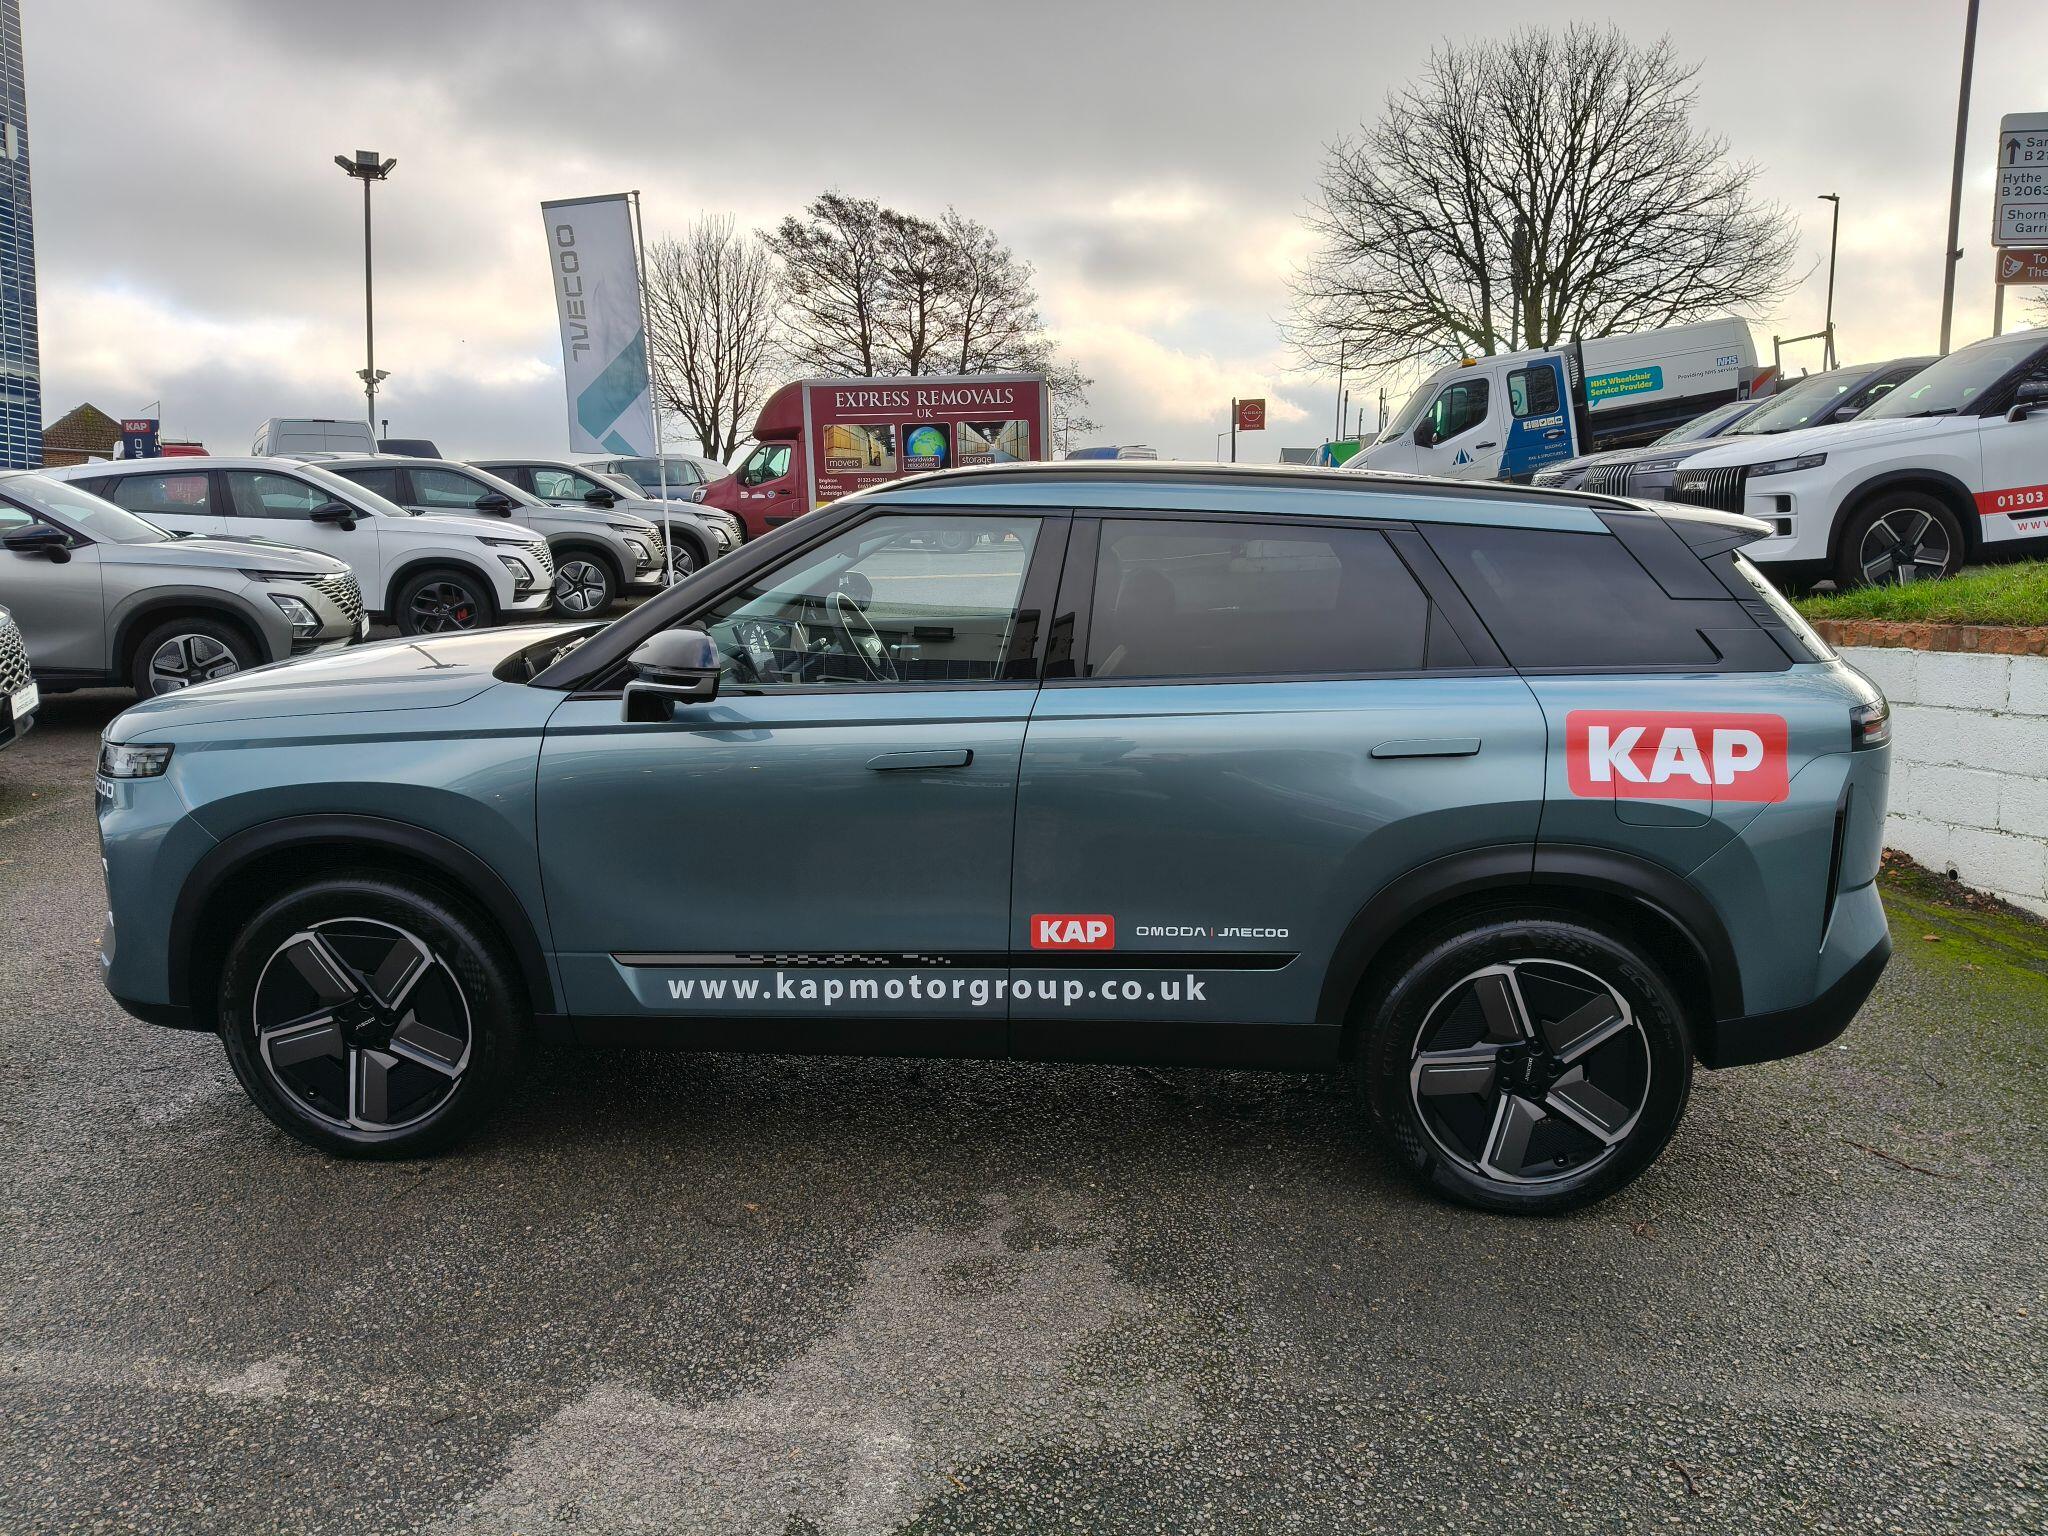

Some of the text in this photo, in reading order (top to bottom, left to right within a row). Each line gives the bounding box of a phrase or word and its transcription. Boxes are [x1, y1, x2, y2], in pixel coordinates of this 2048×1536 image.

[2024, 151, 2033, 161] B
[2002, 173, 2042, 186] Hythe
[2002, 186, 2048, 196] B 2063
[2007, 209, 2048, 220] Shorn
[556, 224, 590, 362] JAECOO
[1717, 355, 1738, 366] NHS
[1590, 372, 1652, 388] NHS Wheelchair
[1677, 370, 1704, 380] Providing
[1590, 380, 1653, 396] Service Provider
[834, 388, 1014, 408] EXPRESS REMOVALS
[916, 408, 934, 418] UK
[125, 422, 148, 431] KAP
[829, 459, 859, 467] movers
[962, 455, 992, 465] storage
[1997, 491, 2044, 507] 01303
[1588, 725, 1764, 785] KAP
[1040, 920, 1108, 943] KAP
[1136, 926, 1289, 938] OMODA JAECOO
[668, 971, 1207, 1007] www.kapmotorgroup.co.uk
